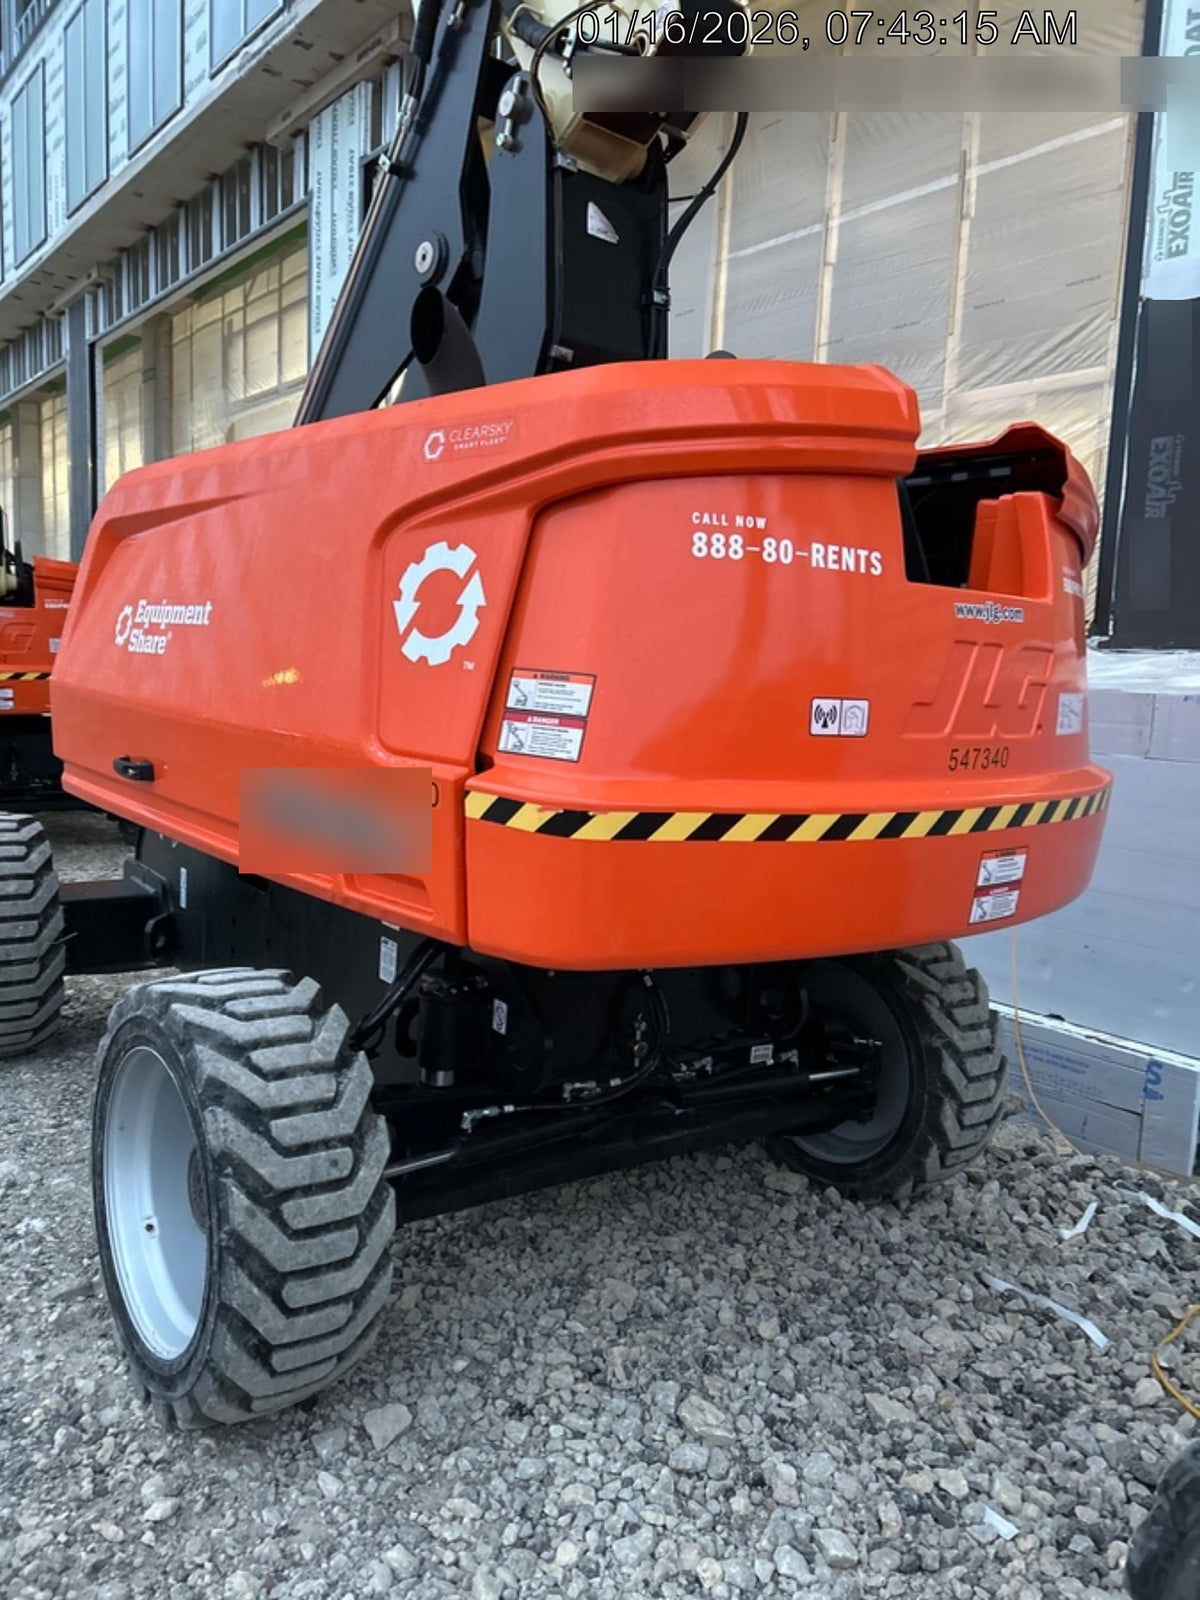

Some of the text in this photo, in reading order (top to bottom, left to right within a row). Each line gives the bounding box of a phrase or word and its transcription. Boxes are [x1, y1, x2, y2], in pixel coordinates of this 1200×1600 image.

[1167, 172, 1195, 259] EXOAIR
[449, 421, 513, 443] CLEARSKY
[692, 511, 767, 530] CALL NOW
[691, 531, 882, 577] 888-80-RENTS
[134, 599, 213, 630] Equipment
[954, 601, 1024, 624] www.jlg.com
[901, 638, 1054, 741] JLG
[948, 747, 1009, 772] 547340
